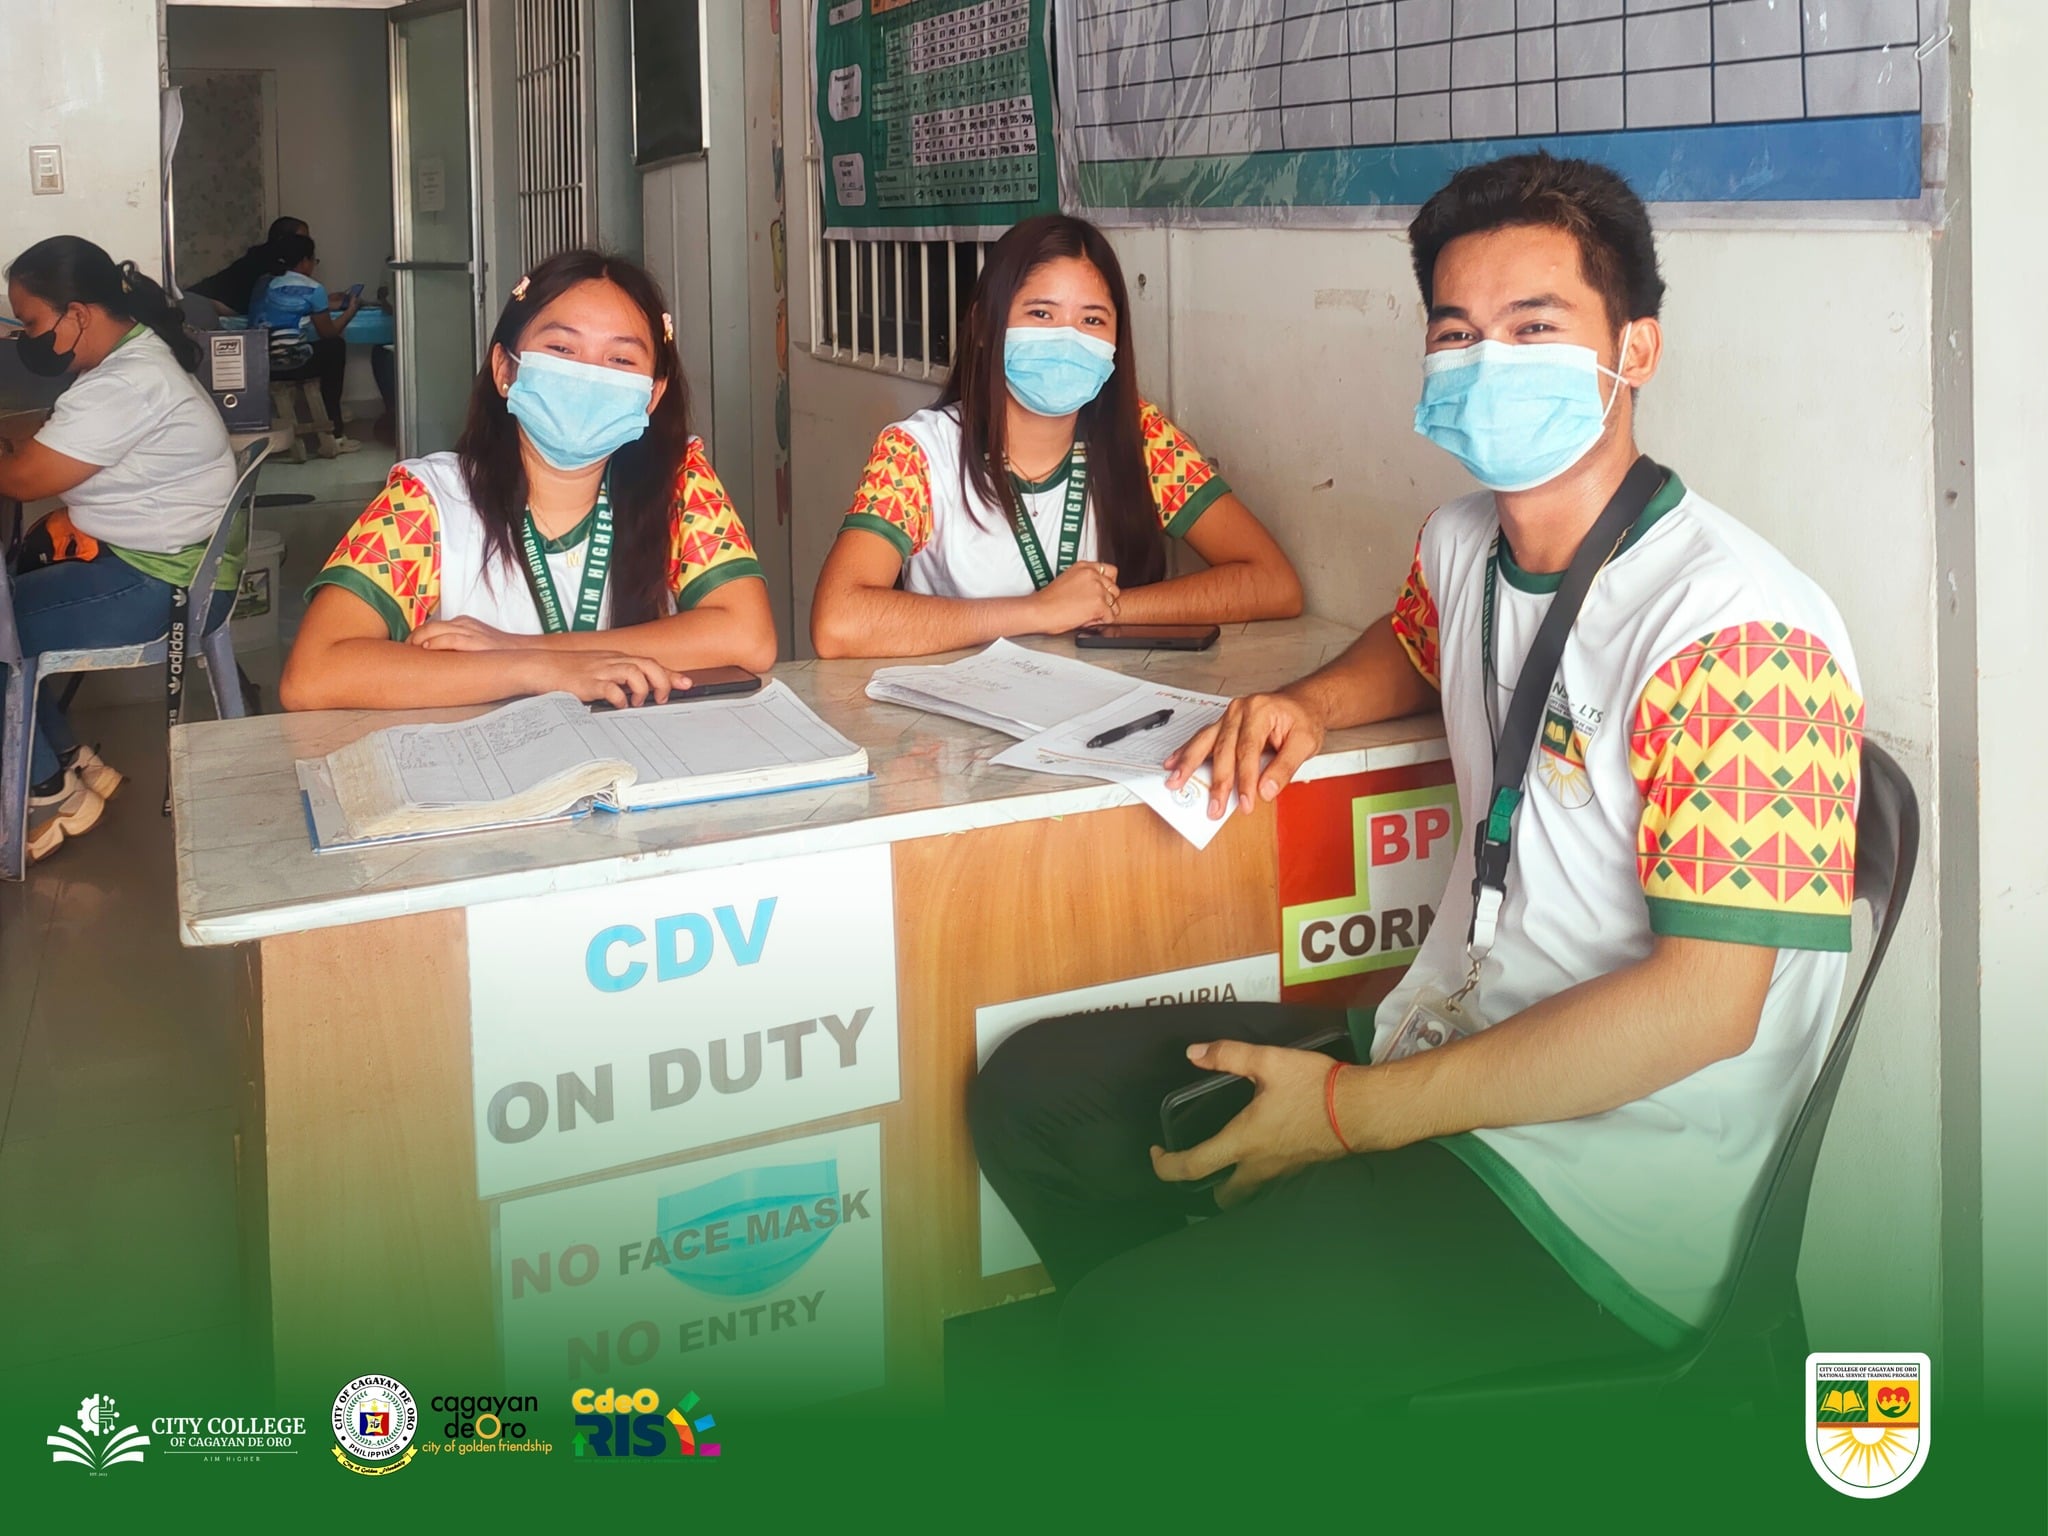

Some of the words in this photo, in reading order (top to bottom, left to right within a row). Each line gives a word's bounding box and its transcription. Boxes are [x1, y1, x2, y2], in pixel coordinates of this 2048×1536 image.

[1063, 469, 1087, 532] HIGHER
[524, 539, 544, 577] COLLEGE
[588, 508, 614, 579] HIGHER
[1019, 533, 1032, 544] OF
[1024, 544, 1046, 580] CAGAYAN
[535, 577, 548, 590] OF
[540, 590, 561, 630] CAGAYAN
[579, 588, 601, 624] AIM
[168, 622, 185, 675] adidas
[1578, 704, 1604, 723] LTS
[1371, 808, 1450, 866] BP
[585, 896, 778, 993] CDV
[1301, 903, 1438, 963] CORN
[487, 1063, 614, 1144] ON
[648, 1006, 875, 1111] DUTY
[511, 1243, 600, 1300] NO
[619, 1220, 730, 1276] FACE
[746, 1188, 872, 1245] MASK
[567, 1320, 661, 1382] NO
[679, 1290, 826, 1354] ENTRY
